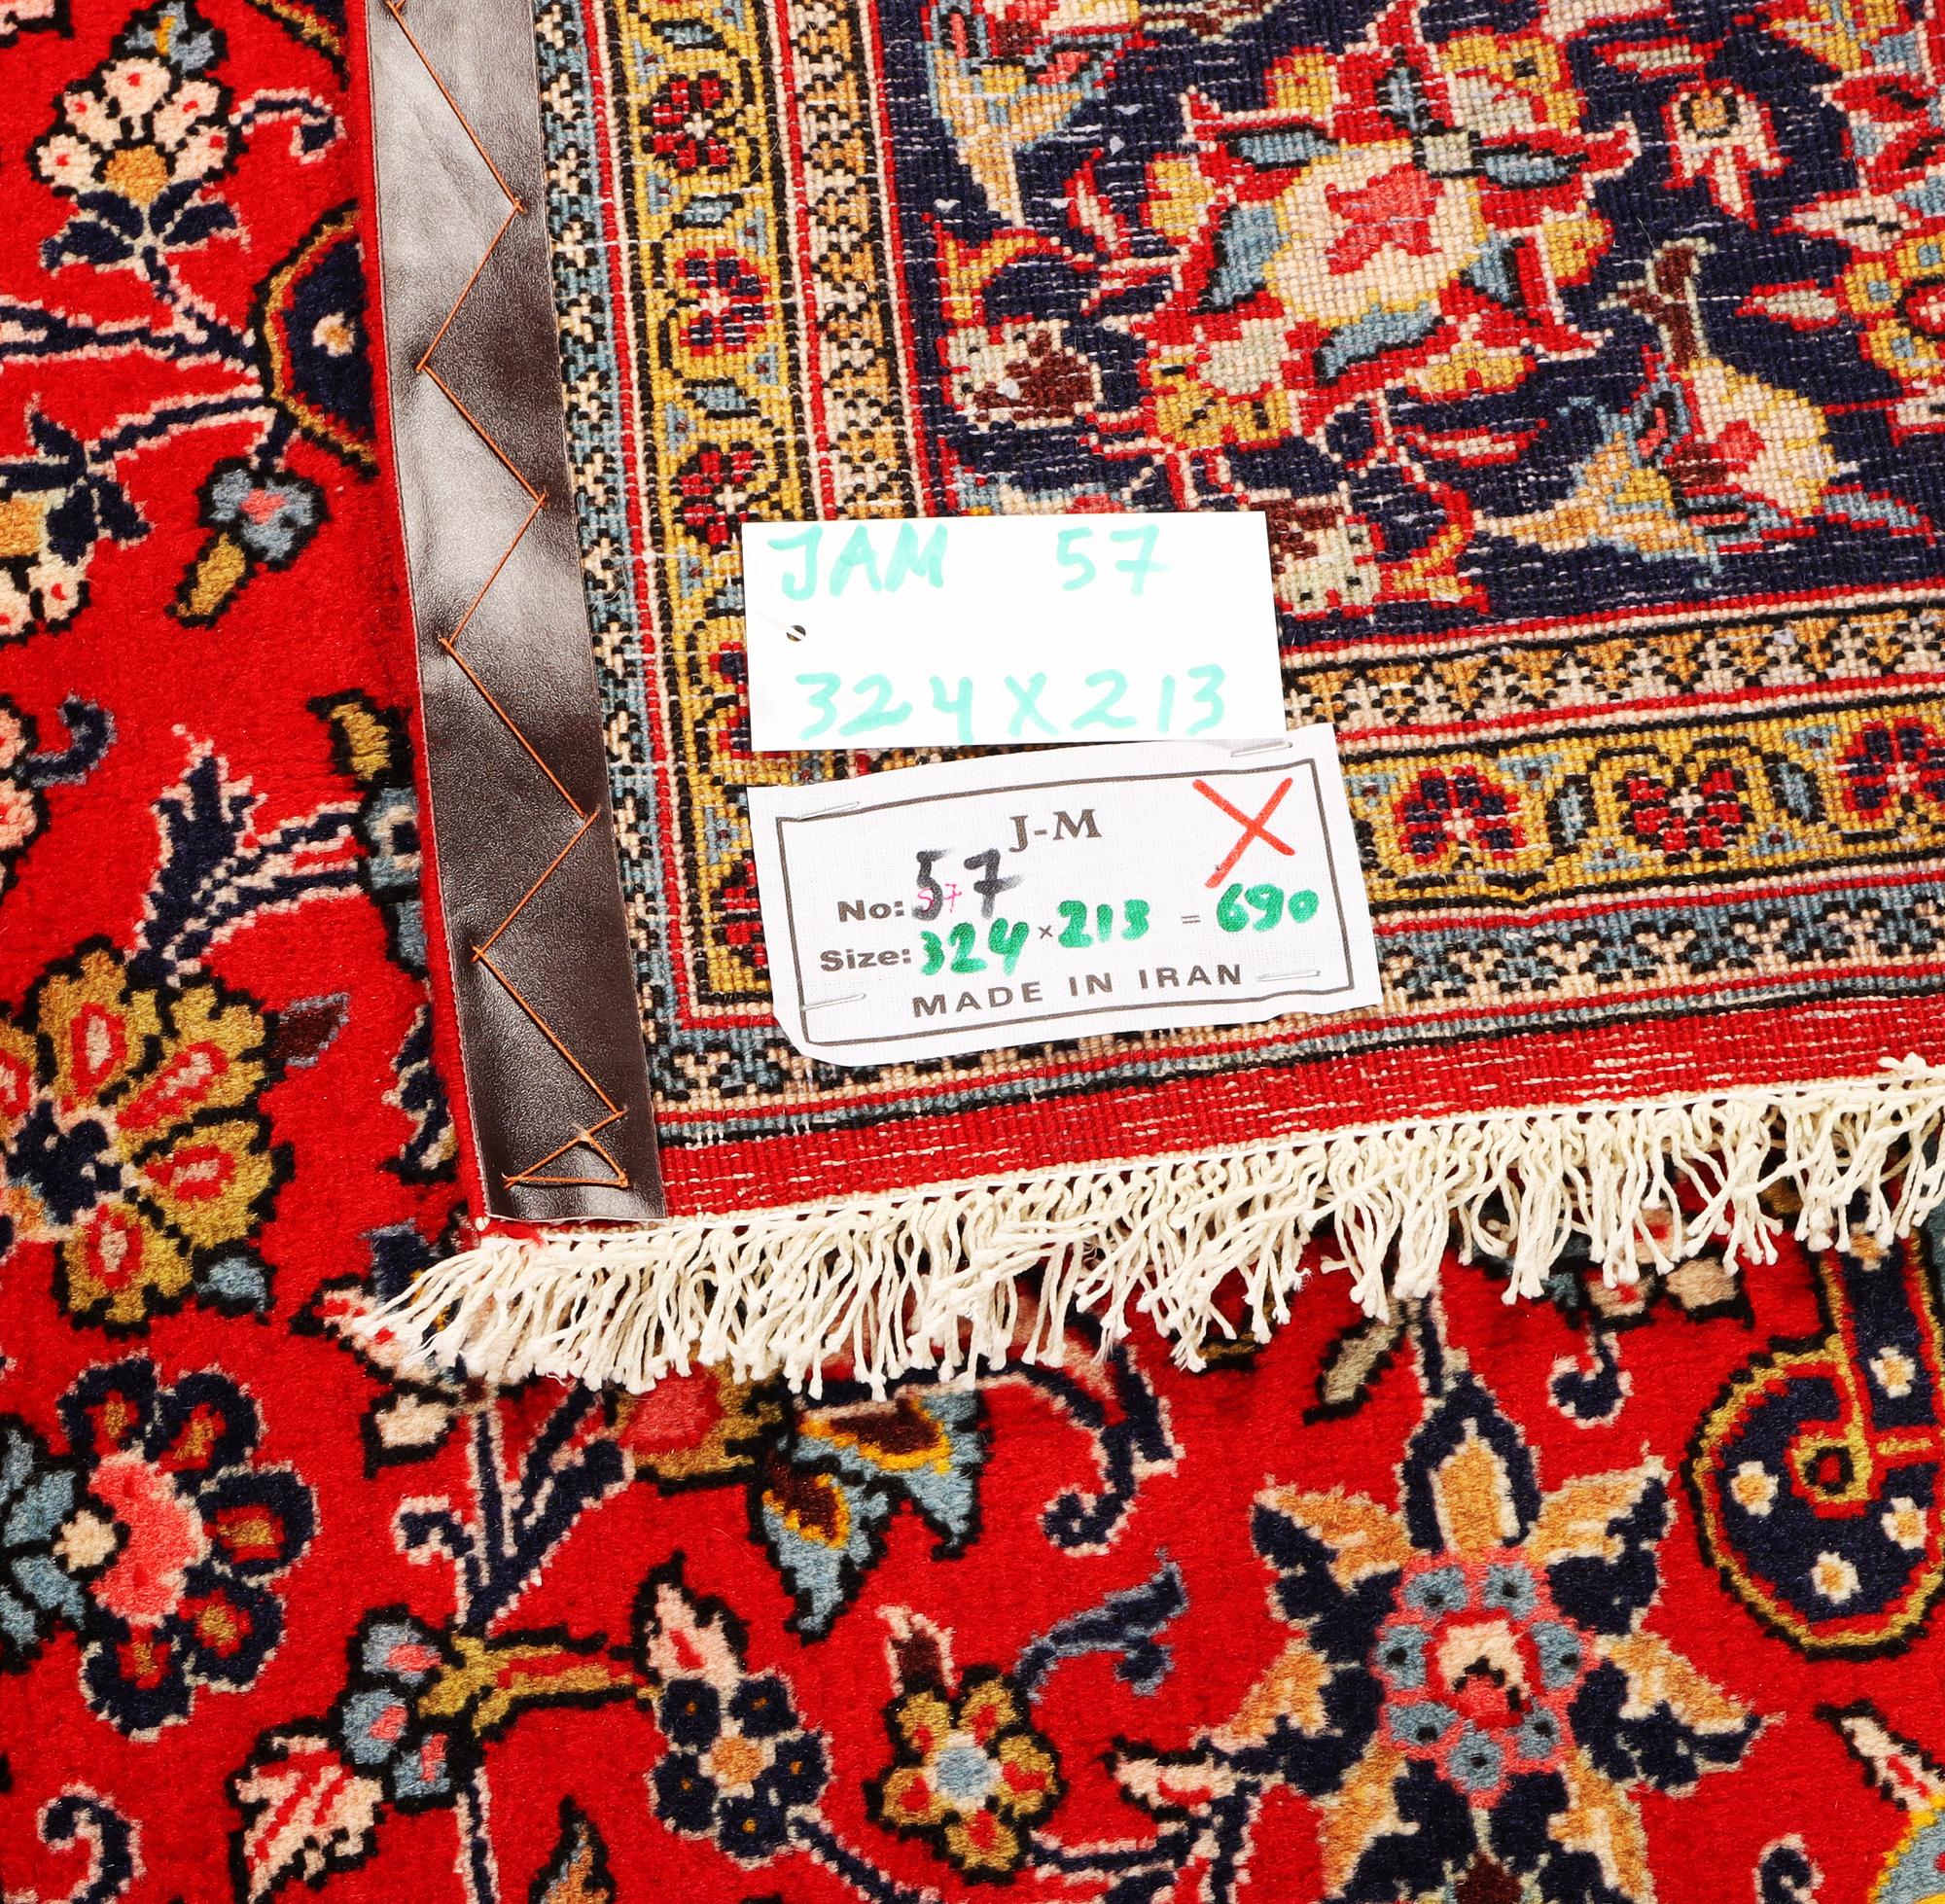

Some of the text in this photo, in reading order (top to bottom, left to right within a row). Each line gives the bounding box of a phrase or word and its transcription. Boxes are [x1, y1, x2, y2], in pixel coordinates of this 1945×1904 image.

[767, 522, 1166, 600] JAM 57
[795, 672, 973, 743] 324
[1071, 664, 1225, 735] 213
[1008, 808, 1103, 853] J-M
[837, 848, 1024, 922] No: 57
[820, 948, 911, 971] Size:
[920, 919, 1029, 973] 324
[1058, 899, 1149, 947] 213
[1217, 883, 1319, 932] 690
[912, 964, 1244, 1018] MADE IN IRAN
